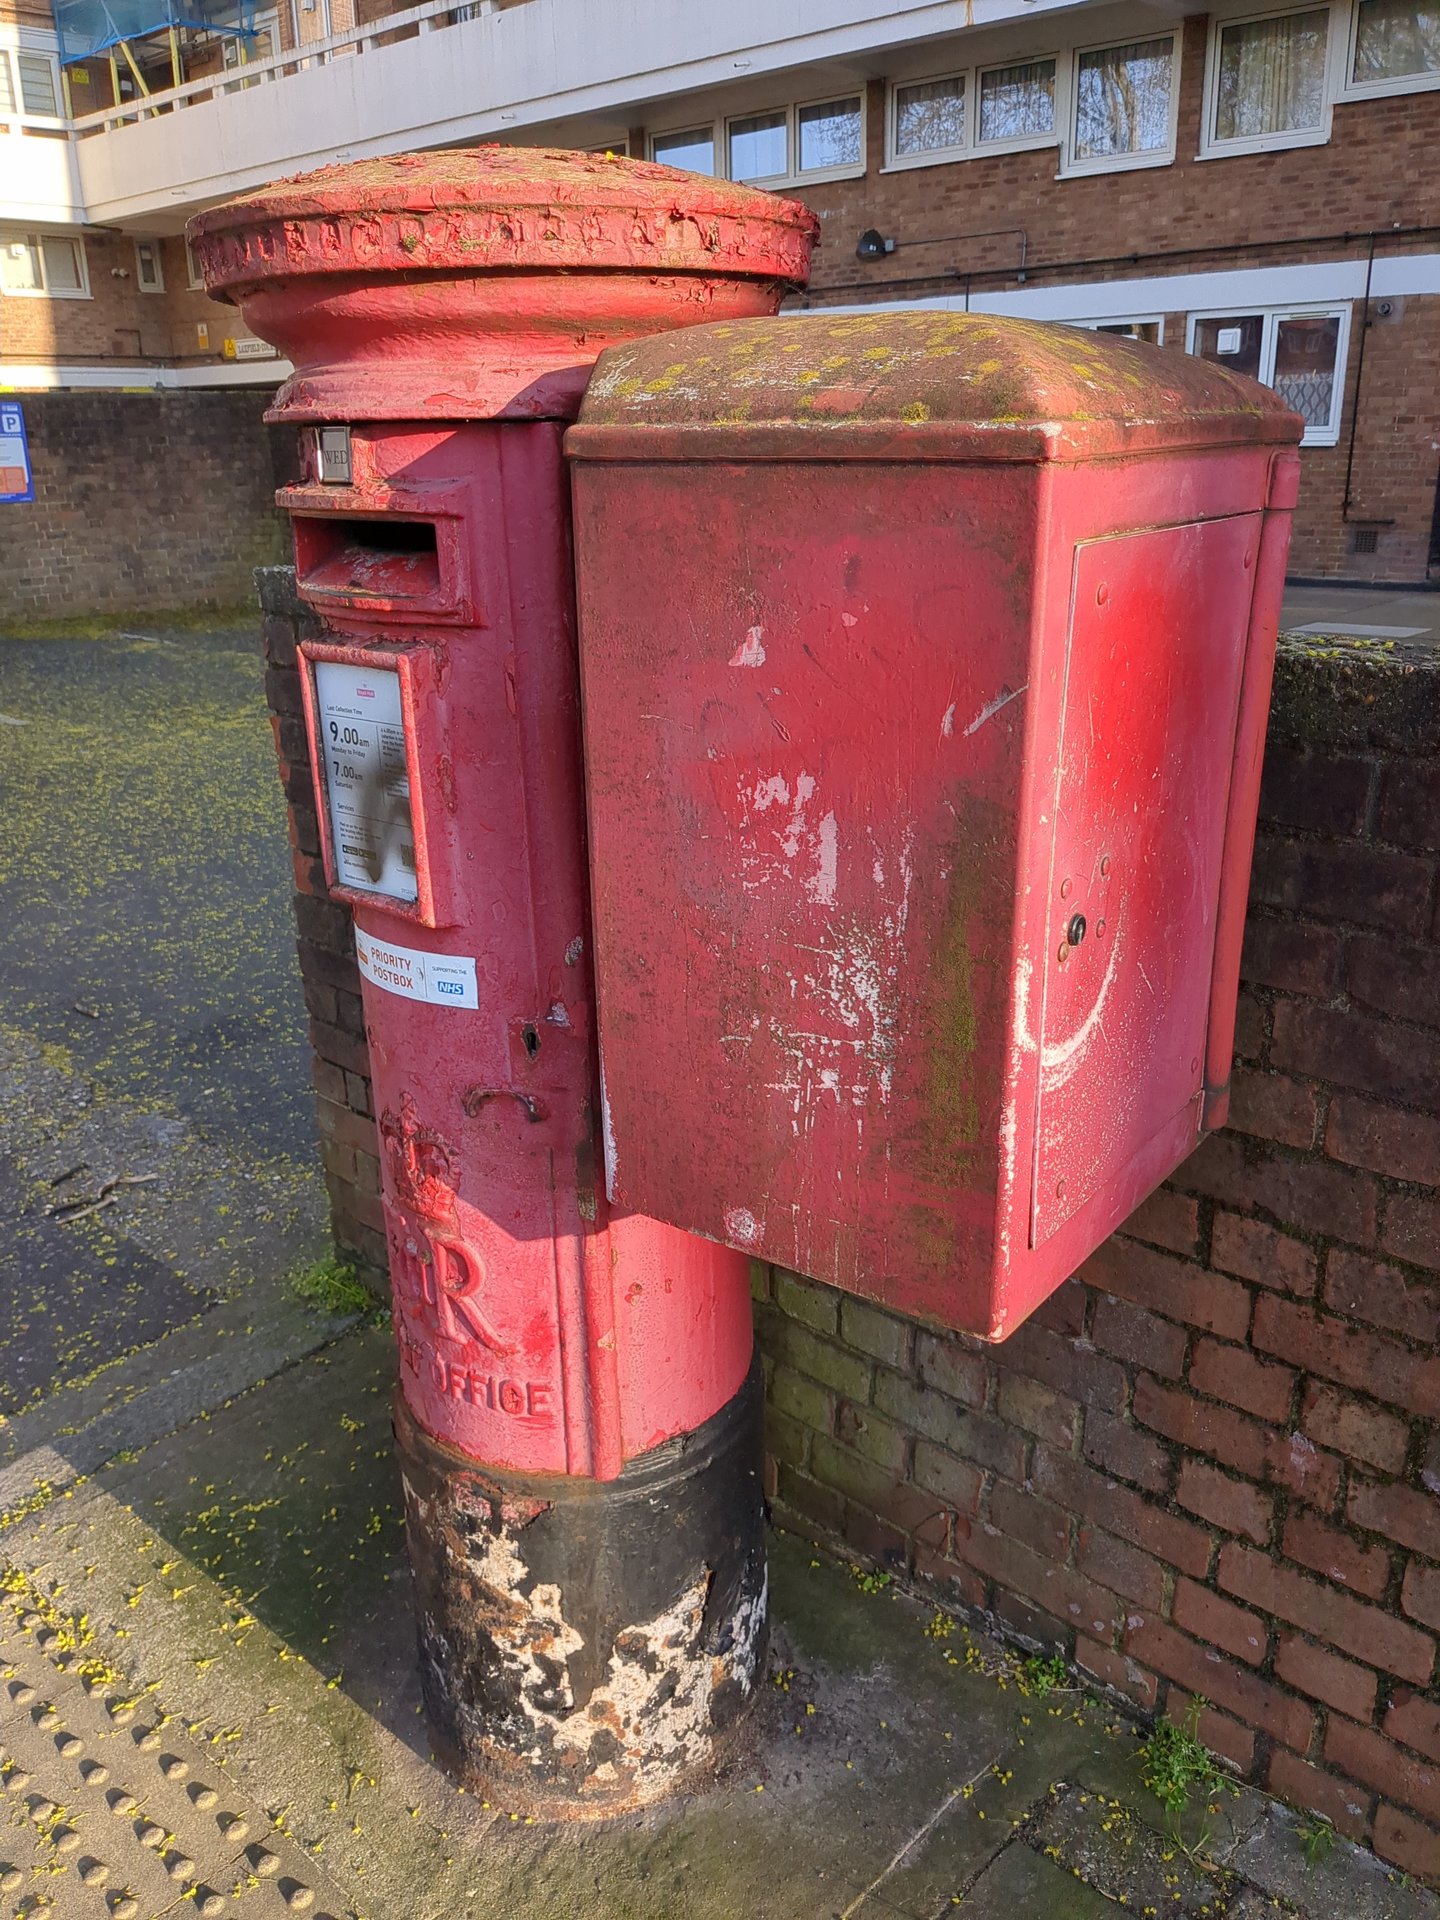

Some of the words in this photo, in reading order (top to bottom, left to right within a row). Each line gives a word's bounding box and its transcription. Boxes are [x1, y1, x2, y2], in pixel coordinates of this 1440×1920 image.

[7, 416, 16, 430] P
[324, 450, 348, 464] WED
[330, 721, 370, 747] 9.00am
[331, 746, 347, 755] Monday
[353, 750, 366, 759] Friday
[333, 761, 363, 780] 7.00am
[371, 947, 411, 971] PRIORITY
[373, 965, 414, 989] POSTBOX
[431, 966, 458, 974] SUPPORTING
[439, 982, 463, 994] NHS
[432, 1351, 552, 1415] OFFICE
